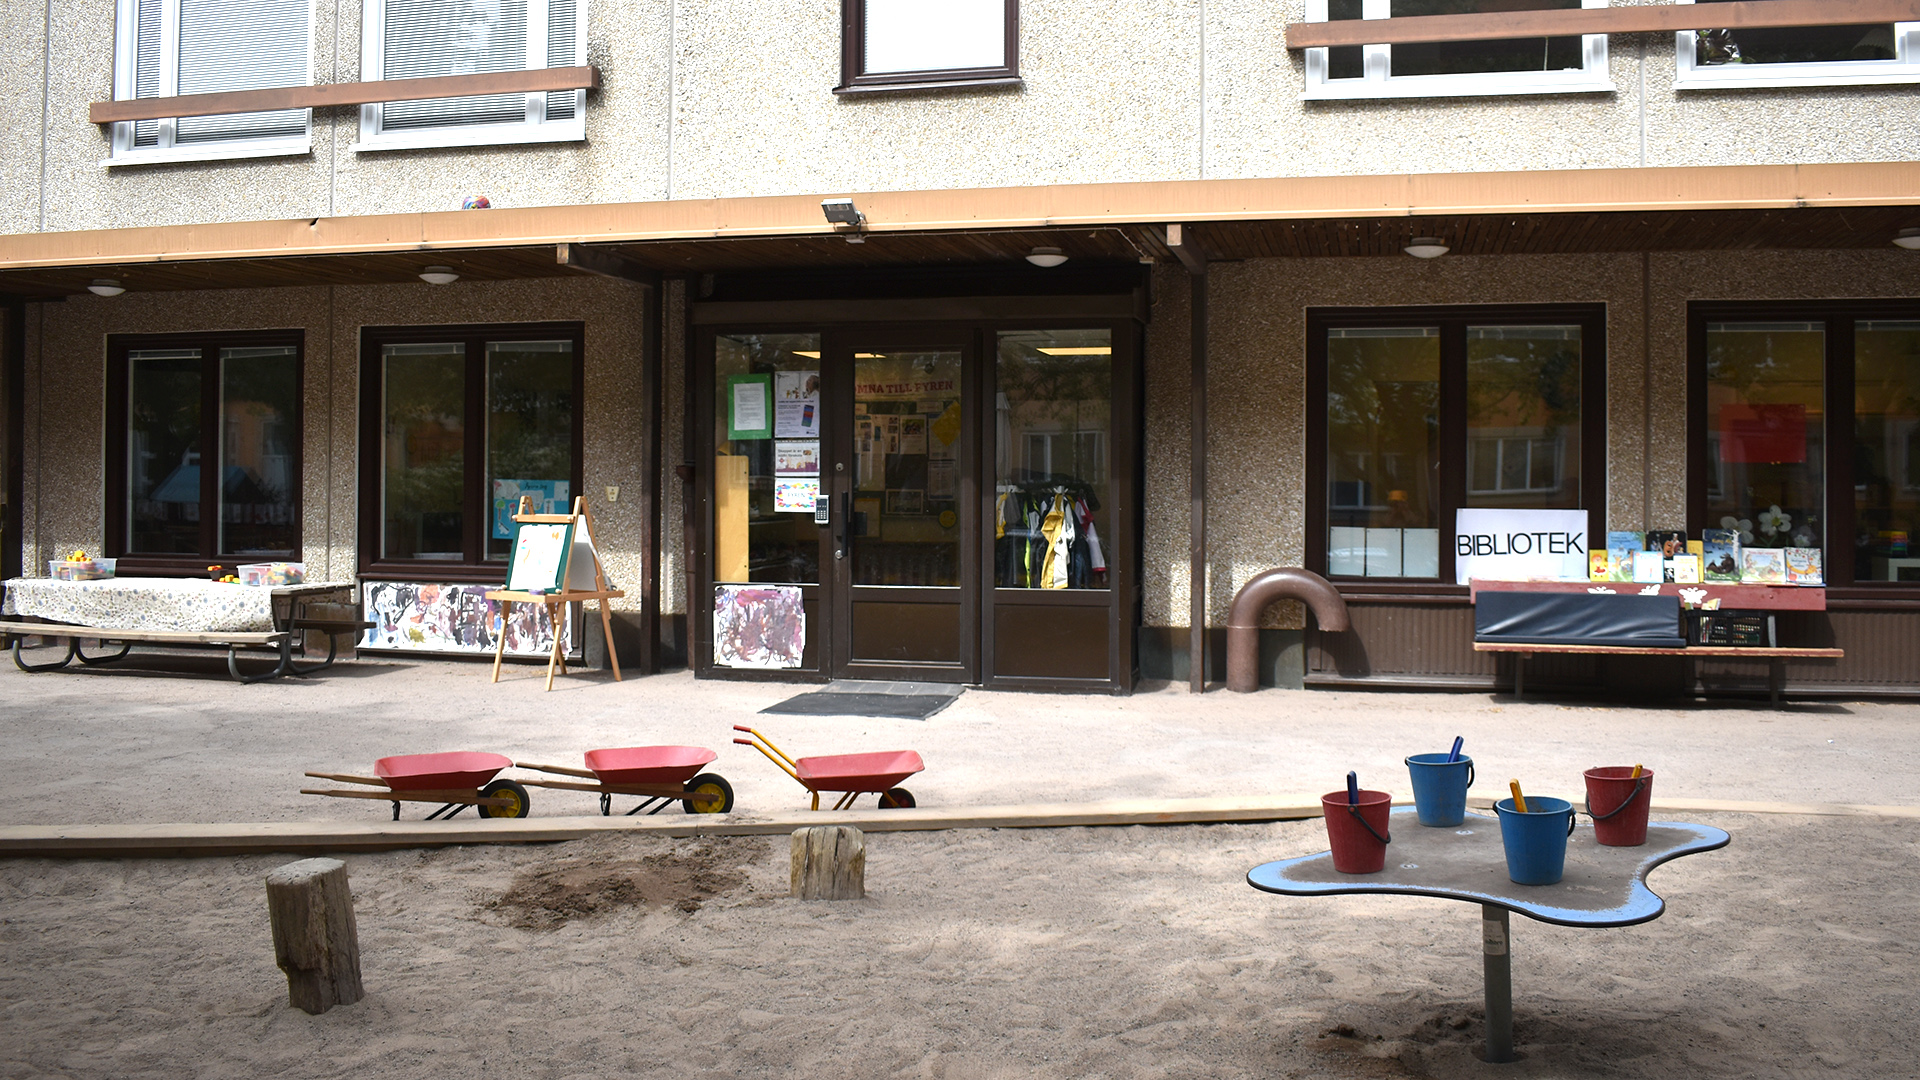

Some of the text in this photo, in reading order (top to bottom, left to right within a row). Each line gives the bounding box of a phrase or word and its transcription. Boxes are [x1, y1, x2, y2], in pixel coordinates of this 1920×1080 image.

[886, 383, 912, 394] TILL
[914, 381, 953, 392] FYREN
[1457, 532, 1585, 556] BIBLIOTEK
